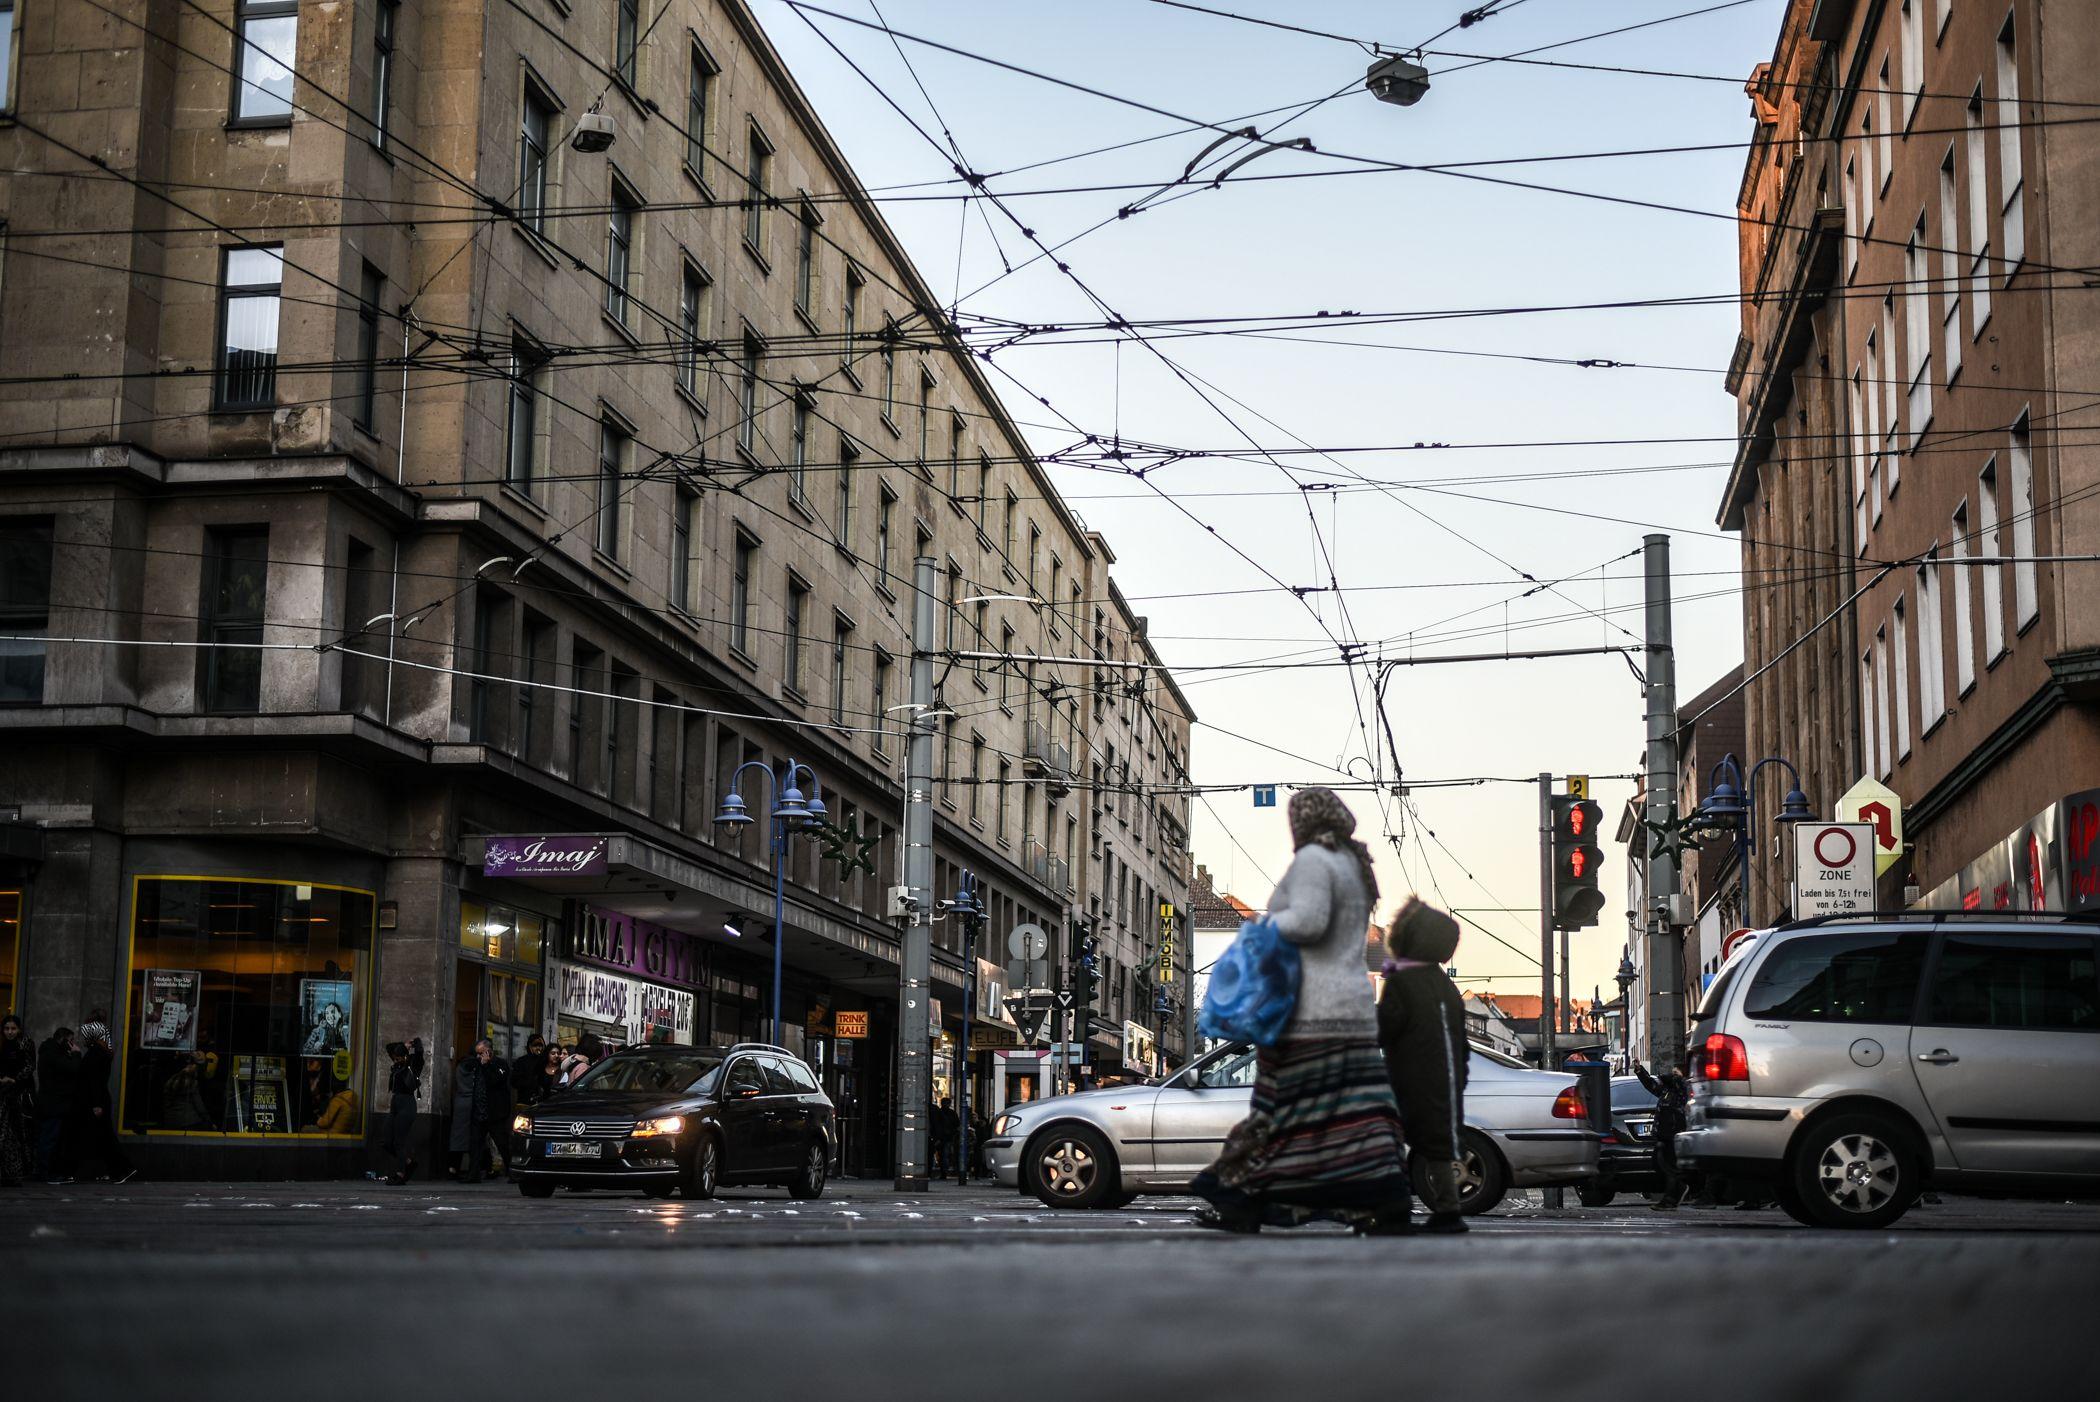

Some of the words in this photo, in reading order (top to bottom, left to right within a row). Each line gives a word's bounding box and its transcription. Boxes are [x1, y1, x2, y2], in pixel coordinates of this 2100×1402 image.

[1574, 780, 1582, 796] 2
[1256, 788, 1272, 804] T
[2069, 802, 2100, 863] AP
[1819, 870, 1852, 880] ZONE
[1800, 889, 1821, 897] Laden
[1825, 889, 1835, 897] bis
[1854, 889, 1871, 897] frei
[1833, 900, 1856, 908] 6-12h
[838, 1014, 866, 1023] TRINK
[838, 1026, 866, 1035] HALLE
